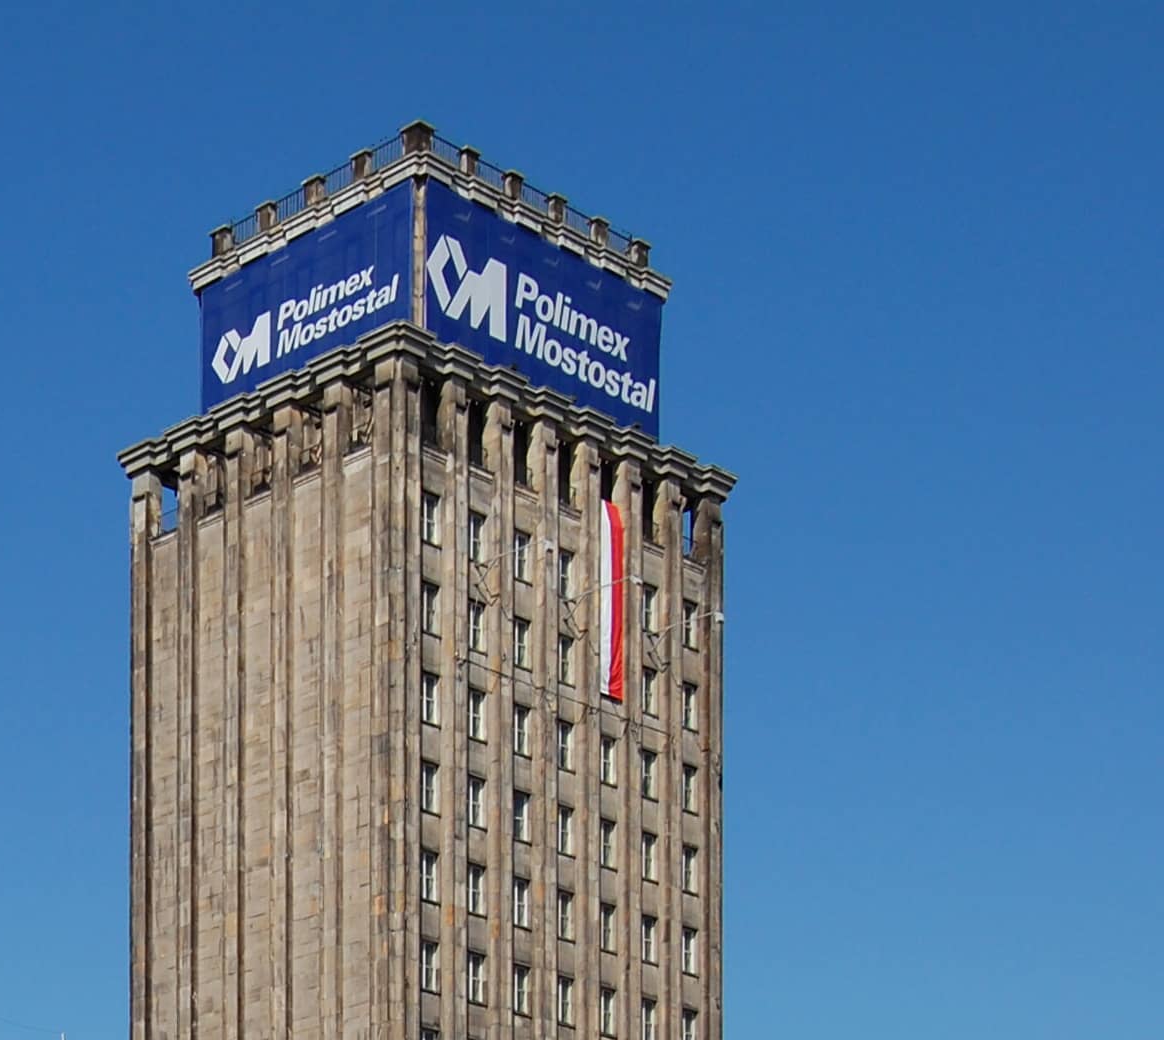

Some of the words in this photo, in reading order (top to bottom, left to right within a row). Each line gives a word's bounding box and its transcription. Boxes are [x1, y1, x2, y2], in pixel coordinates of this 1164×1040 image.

[276, 273, 400, 358] Mostostal
[277, 265, 375, 331] Polimex
[515, 271, 631, 361] Polimex
[515, 314, 656, 413] Mostostal
